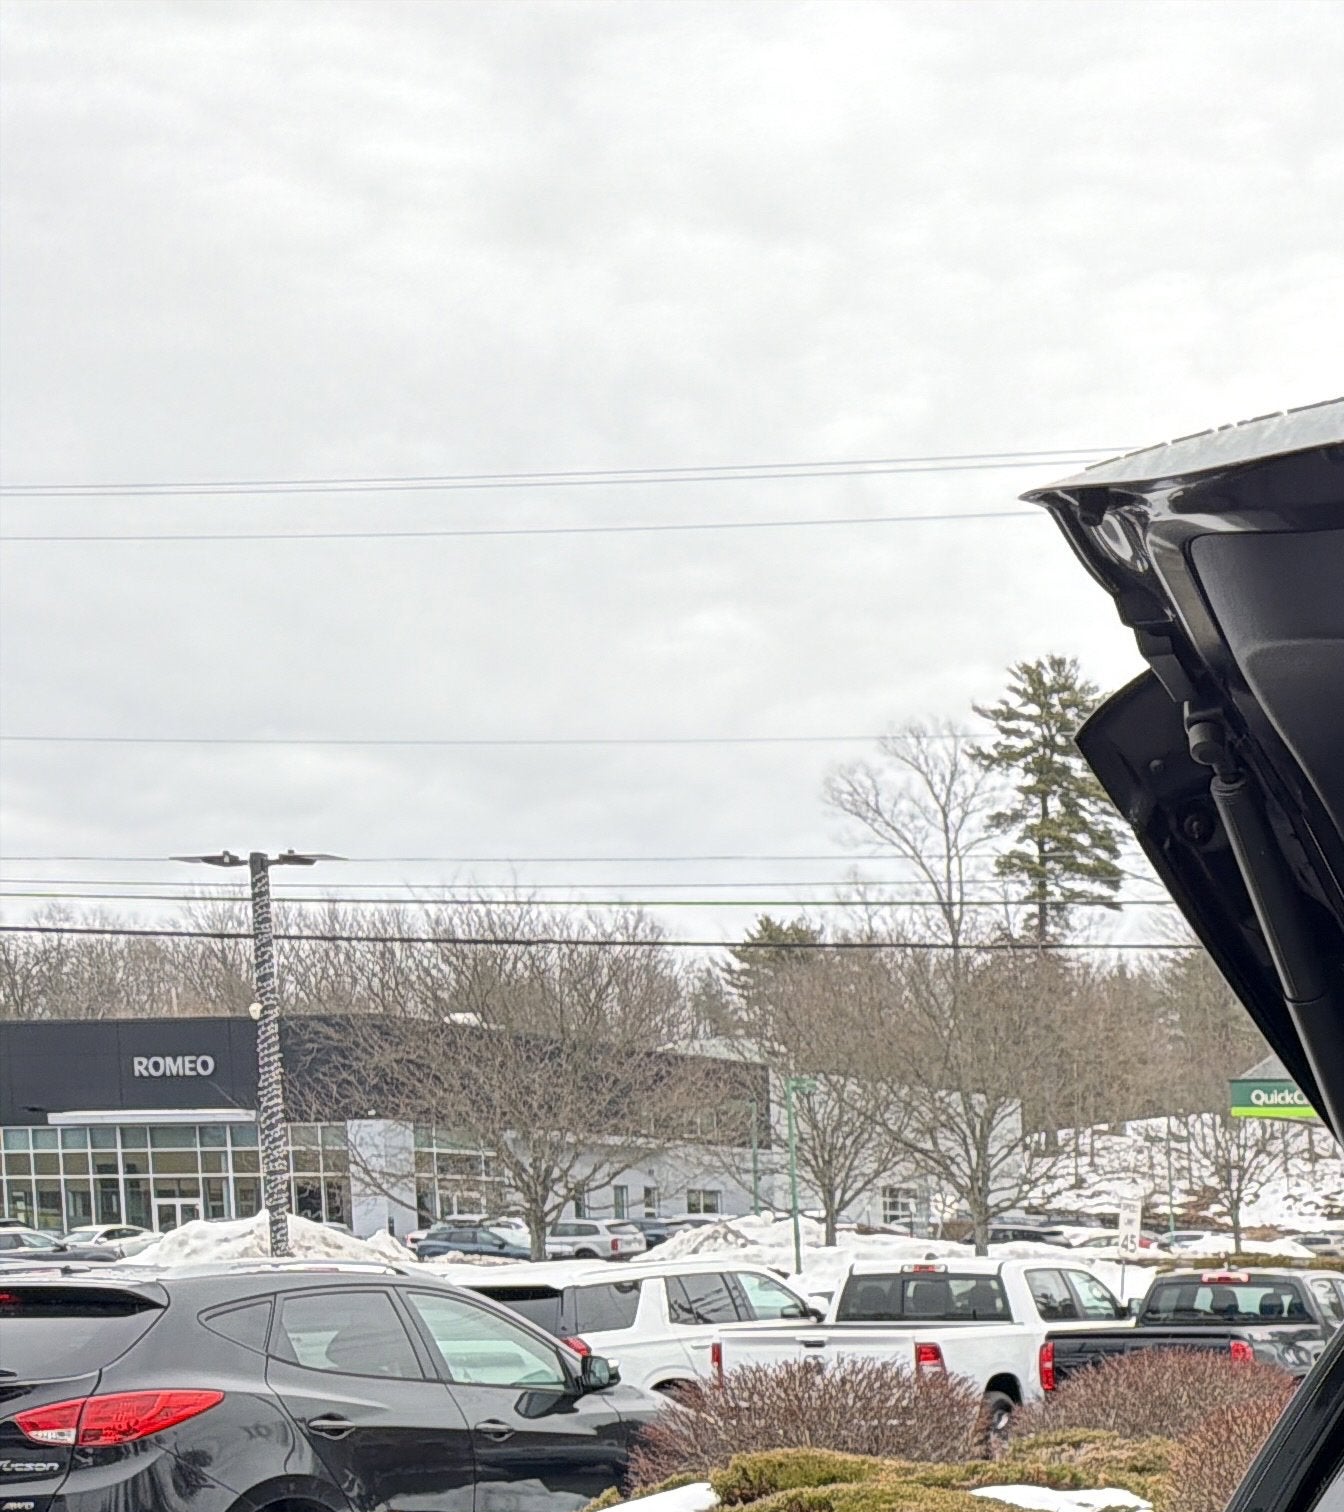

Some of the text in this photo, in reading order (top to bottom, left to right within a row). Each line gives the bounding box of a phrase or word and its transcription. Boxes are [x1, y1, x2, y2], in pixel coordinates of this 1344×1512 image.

[133, 1055, 215, 1077] ROMEO
[1250, 1088, 1309, 1106] QuickC
[1121, 1234, 1137, 1253] 45
